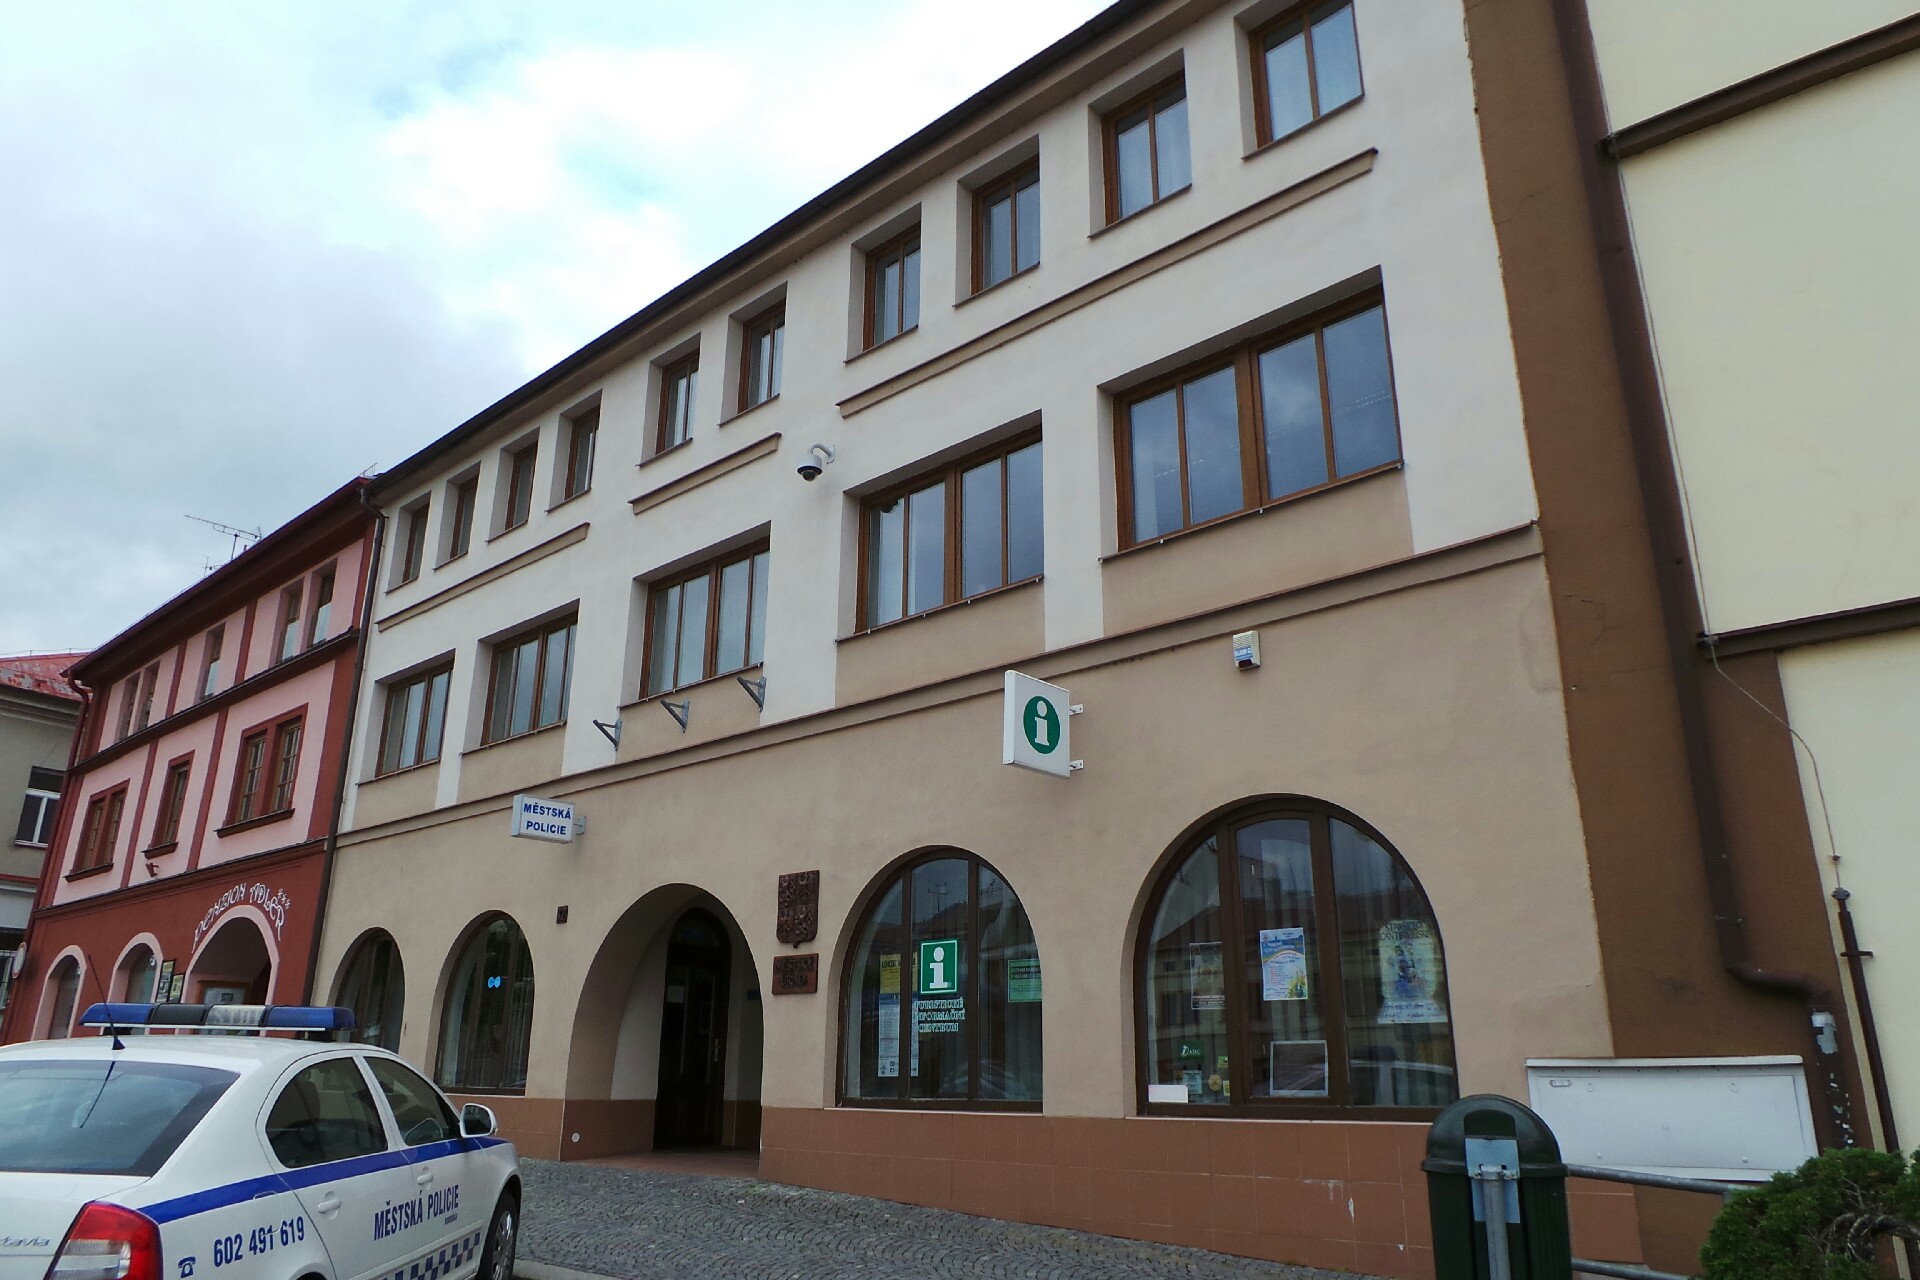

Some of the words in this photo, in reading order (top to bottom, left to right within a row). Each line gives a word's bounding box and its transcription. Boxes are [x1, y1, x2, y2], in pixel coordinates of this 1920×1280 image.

[523, 802, 571, 819] MĚSTSKÁ
[526, 821, 566, 835] POLICIE
[373, 1189, 423, 1241] MĚSTSKÁ
[427, 1185, 459, 1220] POLICIE
[213, 1232, 243, 1268] 602
[249, 1224, 274, 1256] 491
[280, 1216, 305, 1246] 619
